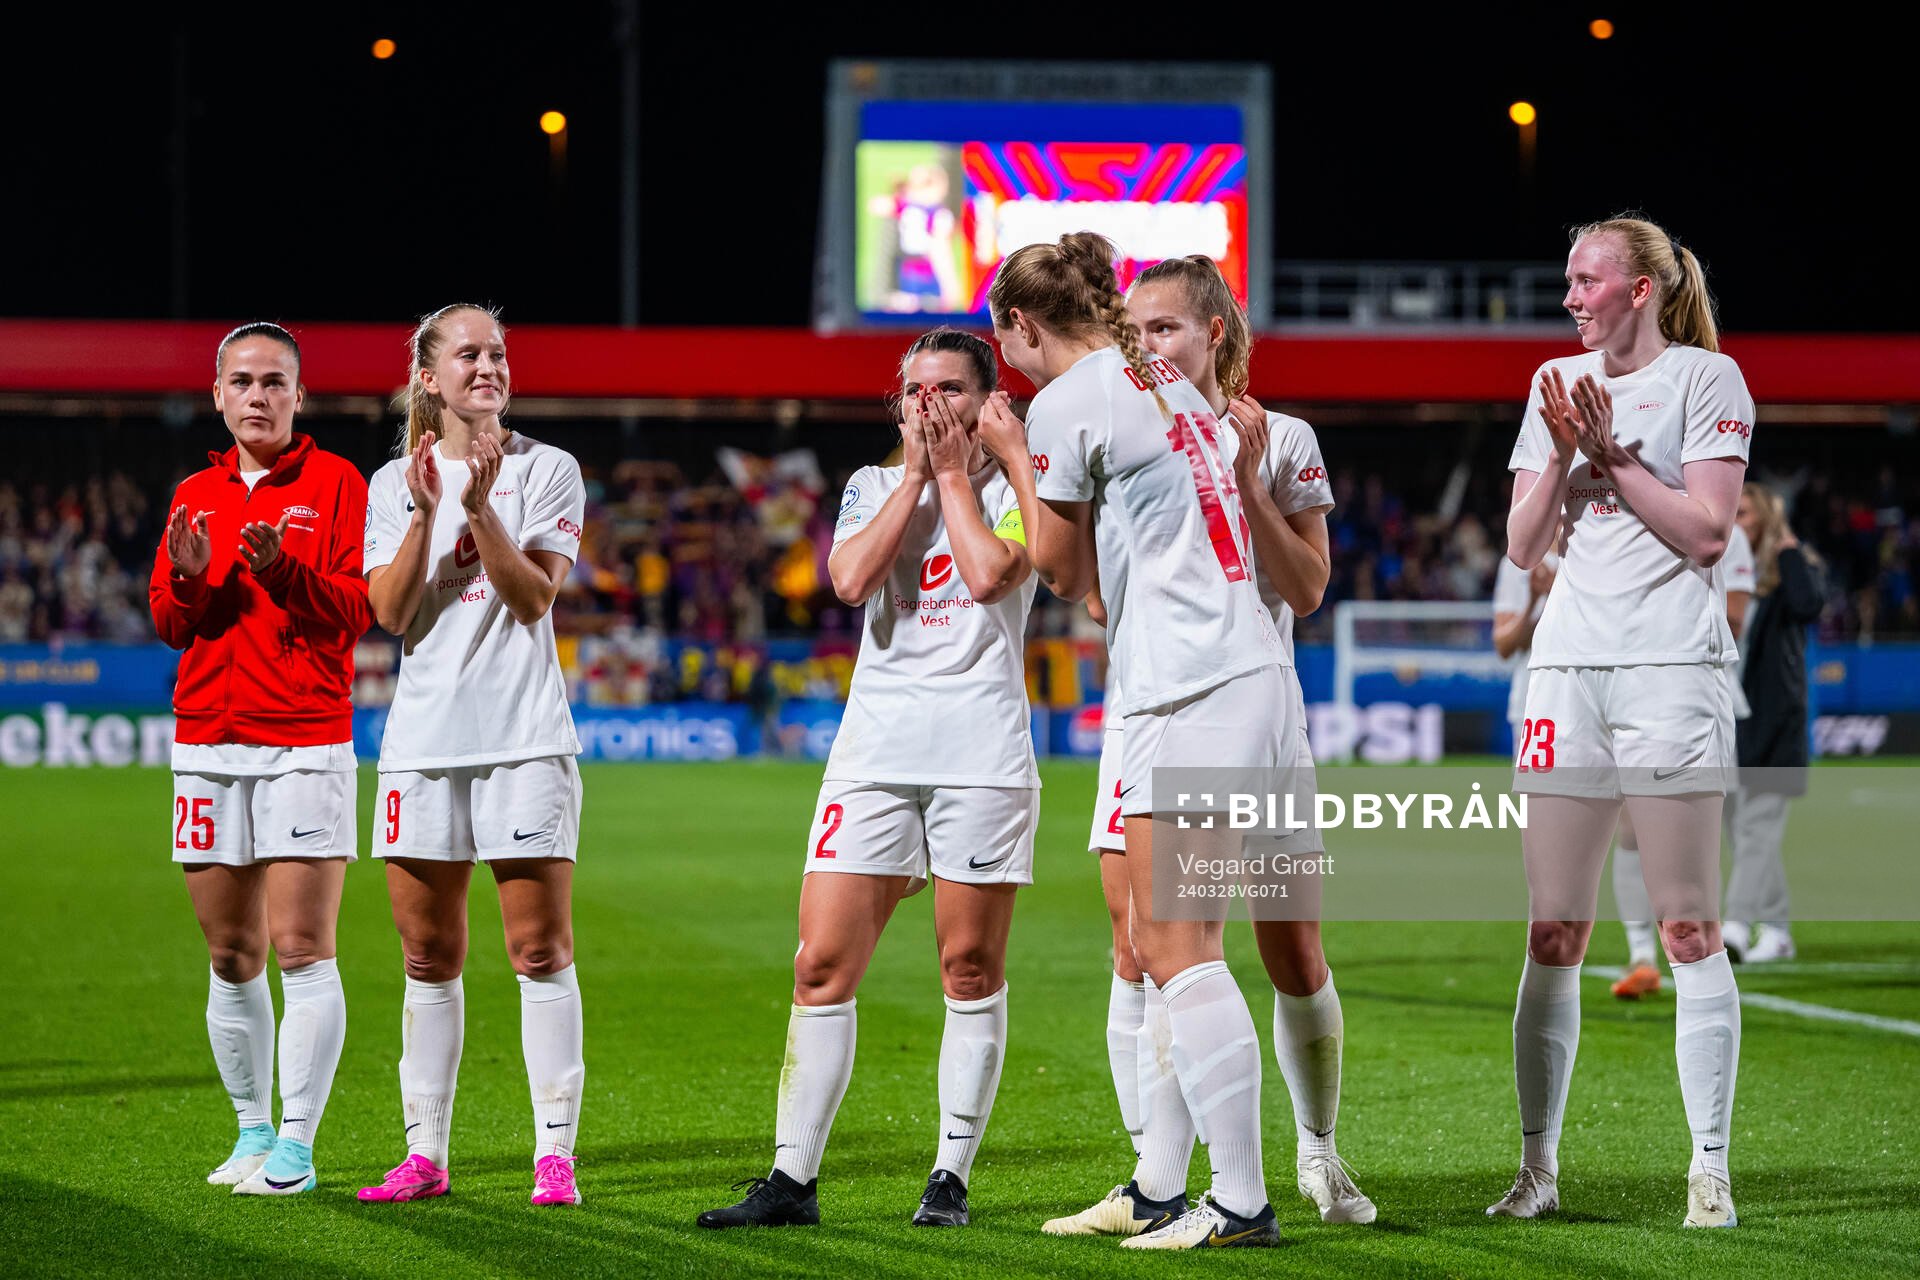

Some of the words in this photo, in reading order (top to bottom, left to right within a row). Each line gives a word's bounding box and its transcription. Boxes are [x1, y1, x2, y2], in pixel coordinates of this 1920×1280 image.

[1717, 419, 1751, 440] coop
[1591, 502, 1620, 515] Vest
[458, 588, 487, 603] Vest
[920, 614, 951, 627] Vest
[1517, 718, 1556, 774] 23
[175, 795, 215, 850] 25
[386, 789, 401, 845] 9
[815, 803, 844, 859] 2
